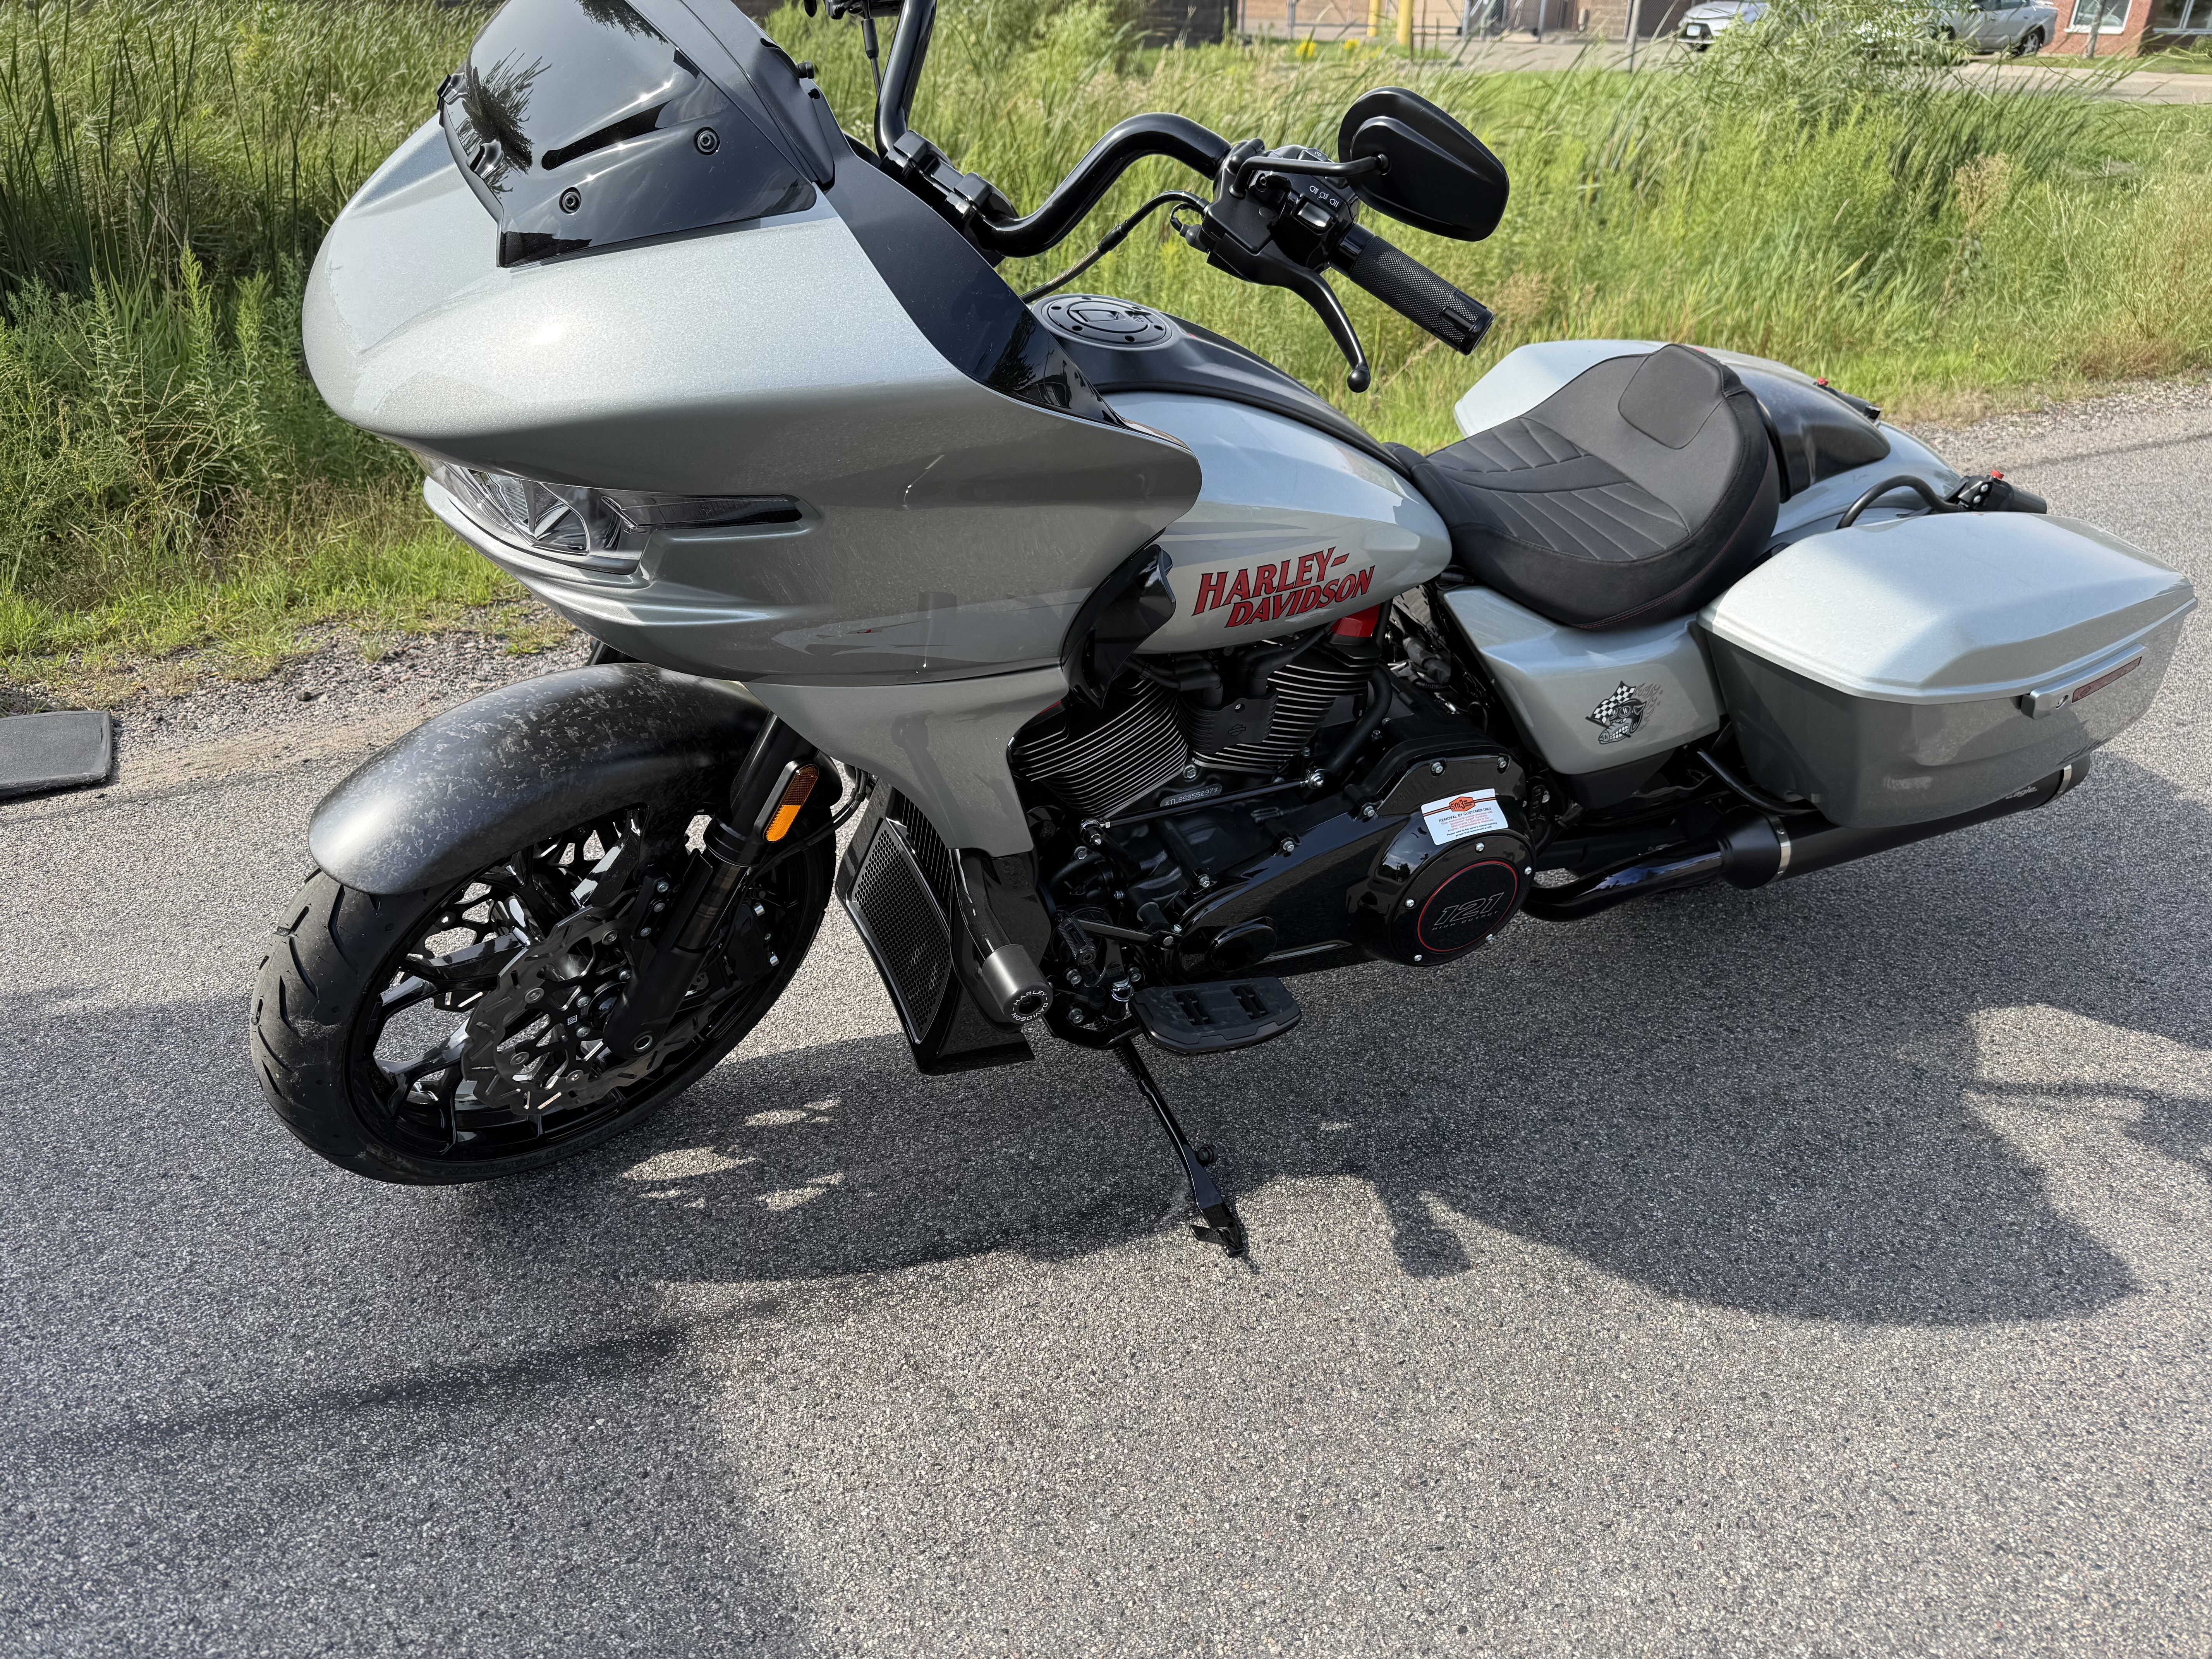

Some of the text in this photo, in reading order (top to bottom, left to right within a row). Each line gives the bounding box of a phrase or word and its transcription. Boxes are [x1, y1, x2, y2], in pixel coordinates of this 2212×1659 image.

[1191, 546, 1350, 616] HARLEY-
[1224, 565, 1376, 628] DAVIDSON
[1434, 892, 1504, 926] 121
